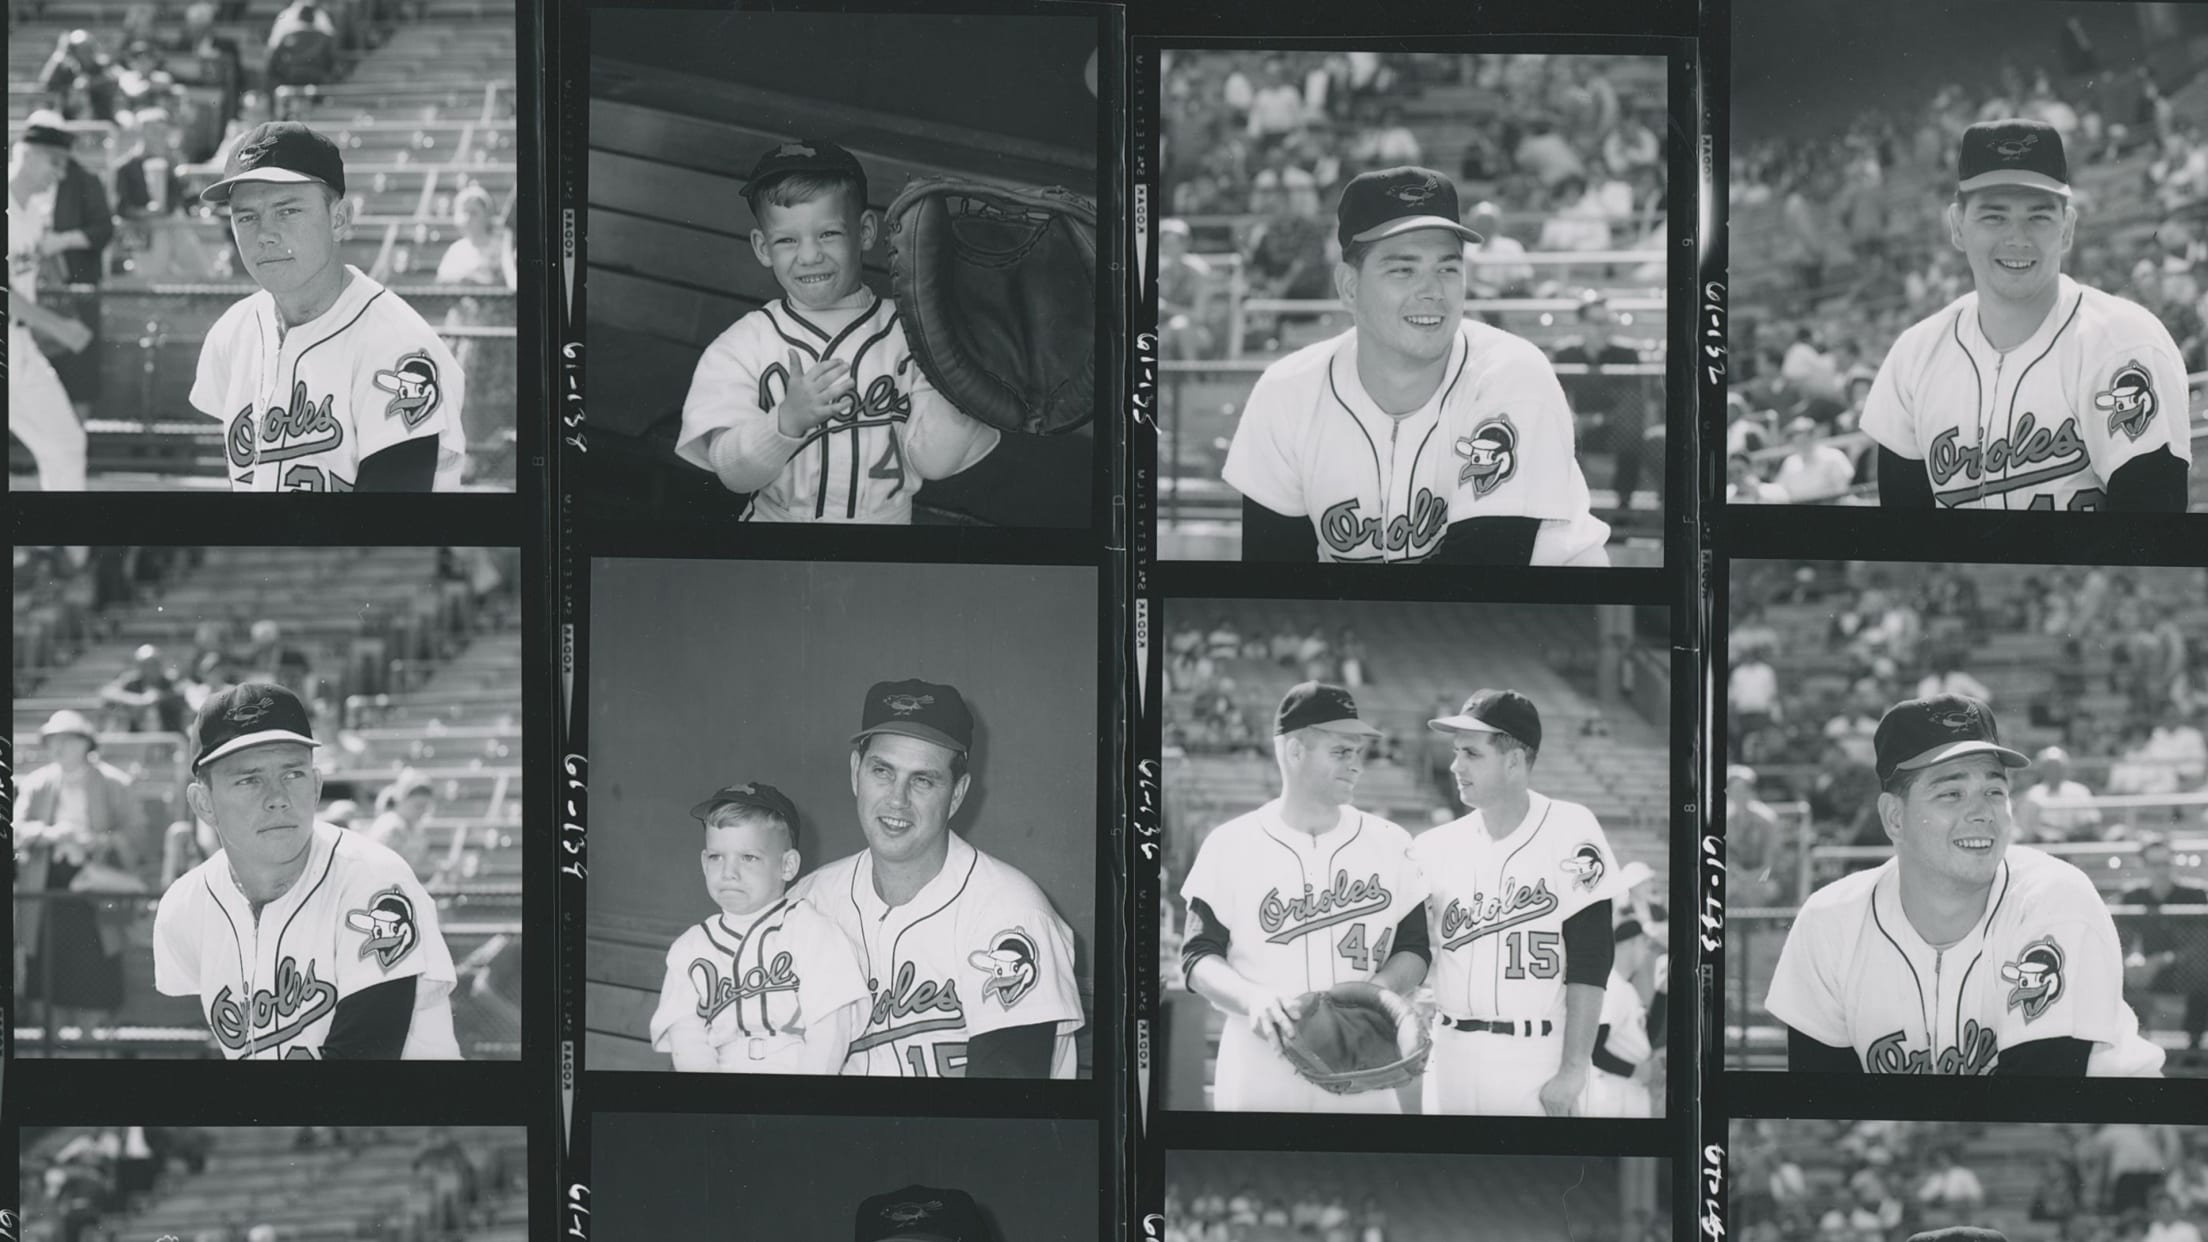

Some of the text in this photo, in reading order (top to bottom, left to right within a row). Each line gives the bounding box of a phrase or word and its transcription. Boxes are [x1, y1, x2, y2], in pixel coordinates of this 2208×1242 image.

[1704, 280, 1727, 384] 61-132
[562, 341, 588, 453] 61-138
[562, 753, 588, 879] 61-139
[1134, 758, 1161, 860] 61-136
[1258, 868, 1393, 945] Orioles
[1441, 877, 1558, 952] Orioles
[1701, 834, 1727, 952] 61-133
[1505, 931, 1560, 980] 15
